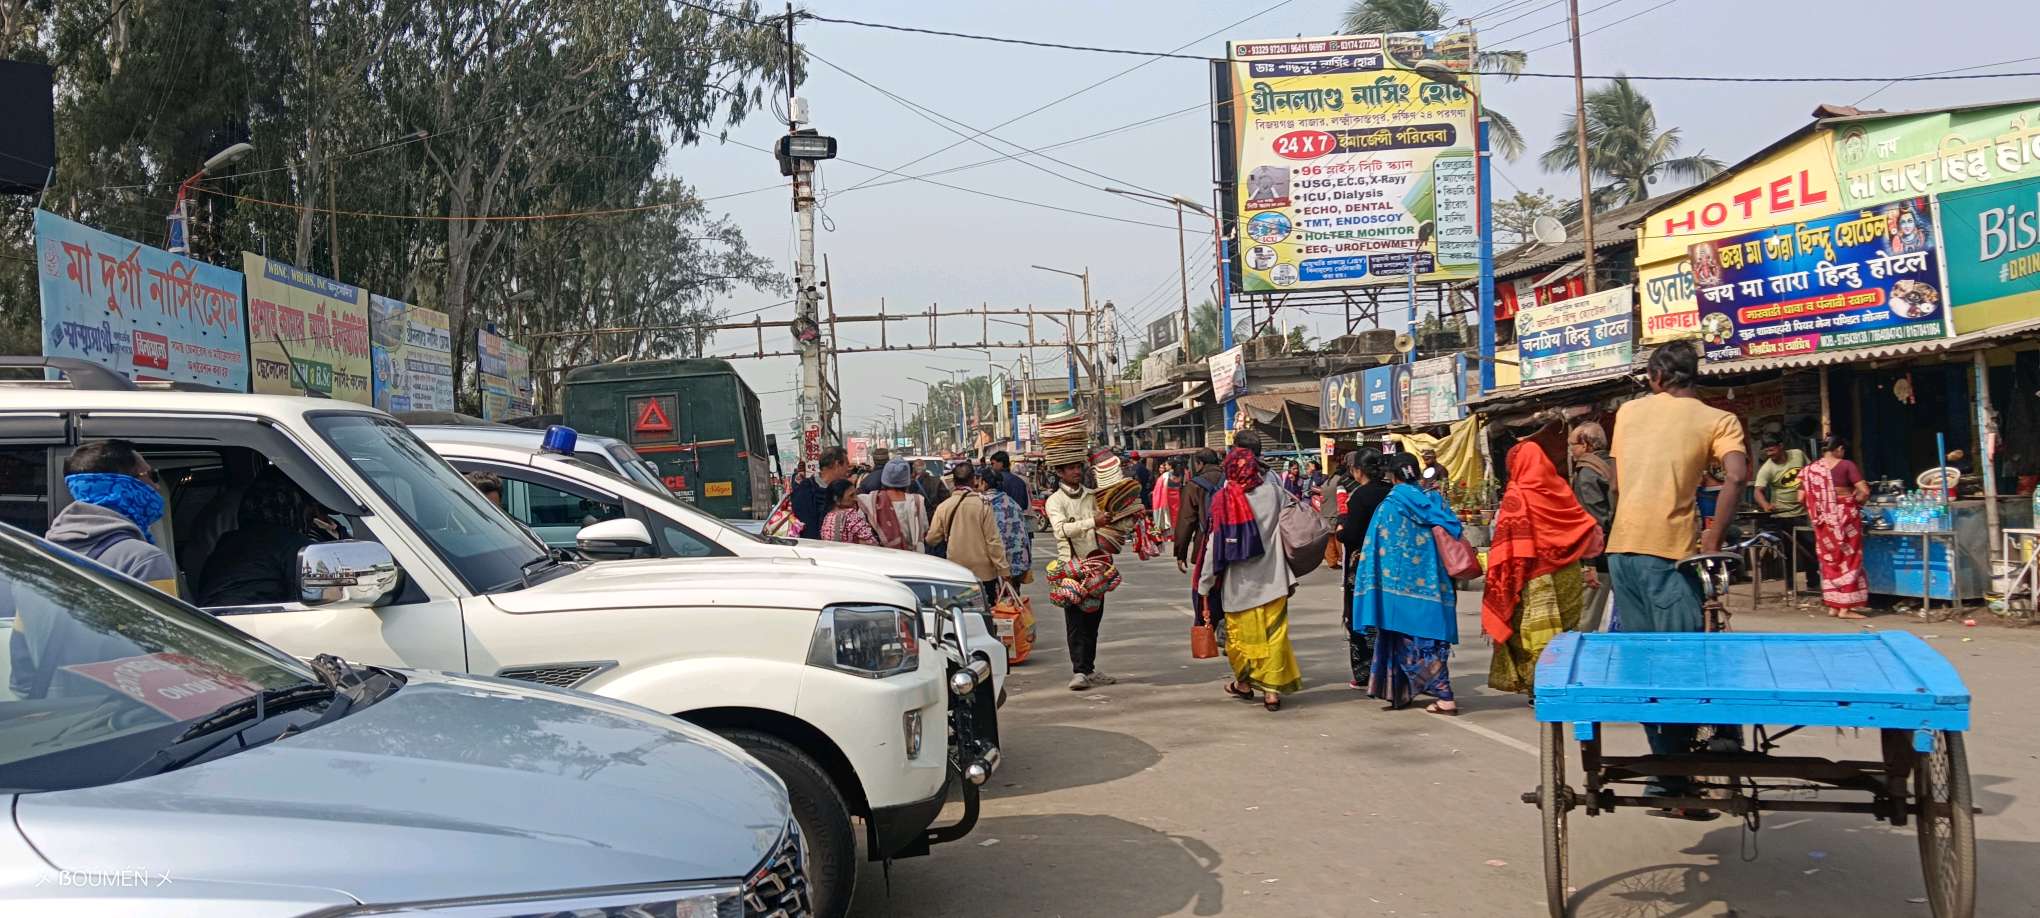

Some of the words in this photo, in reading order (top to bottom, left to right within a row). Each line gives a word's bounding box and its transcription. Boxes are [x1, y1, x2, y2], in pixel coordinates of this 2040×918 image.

[1350, 75, 1410, 108] নার্সিং
[1279, 138, 1298, 153] 24
[1302, 136, 1315, 152] X
[1318, 135, 1328, 151] 7
[1301, 165, 1322, 176] 96
[1333, 188, 1383, 201] Dialysis
[1664, 169, 1828, 236] HOTEL
[1304, 205, 1341, 215] ECHO,
[1345, 201, 1393, 212] DENTAL
[1304, 218, 1332, 228] TMT,
[1336, 213, 1402, 226] ENDOSCOY
[1305, 230, 1353, 241] HOLTER
[1357, 226, 1415, 238] MONITOR
[1718, 244, 1744, 270] জয়
[1744, 240, 1762, 264] মা
[1764, 234, 1794, 261] তারা
[1795, 223, 1837, 265] হিন্দু
[1835, 210, 1889, 247] হোটেল
[1305, 244, 1332, 254] EEG,
[1702, 284, 1734, 303] जय
[1738, 279, 1764, 298] मा
[1767, 271, 1810, 294] तारा
[1814, 260, 1863, 288] हिन्दु
[1865, 250, 1928, 278] होटल
[61, 239, 92, 297] মা
[98, 245, 143, 320] দুর্গা
[147, 260, 240, 336] নার্সিংহোম
[1521, 330, 1562, 352] जनप्रिय
[1565, 325, 1591, 347] हिन्दु
[1594, 319, 1629, 340] होटल
